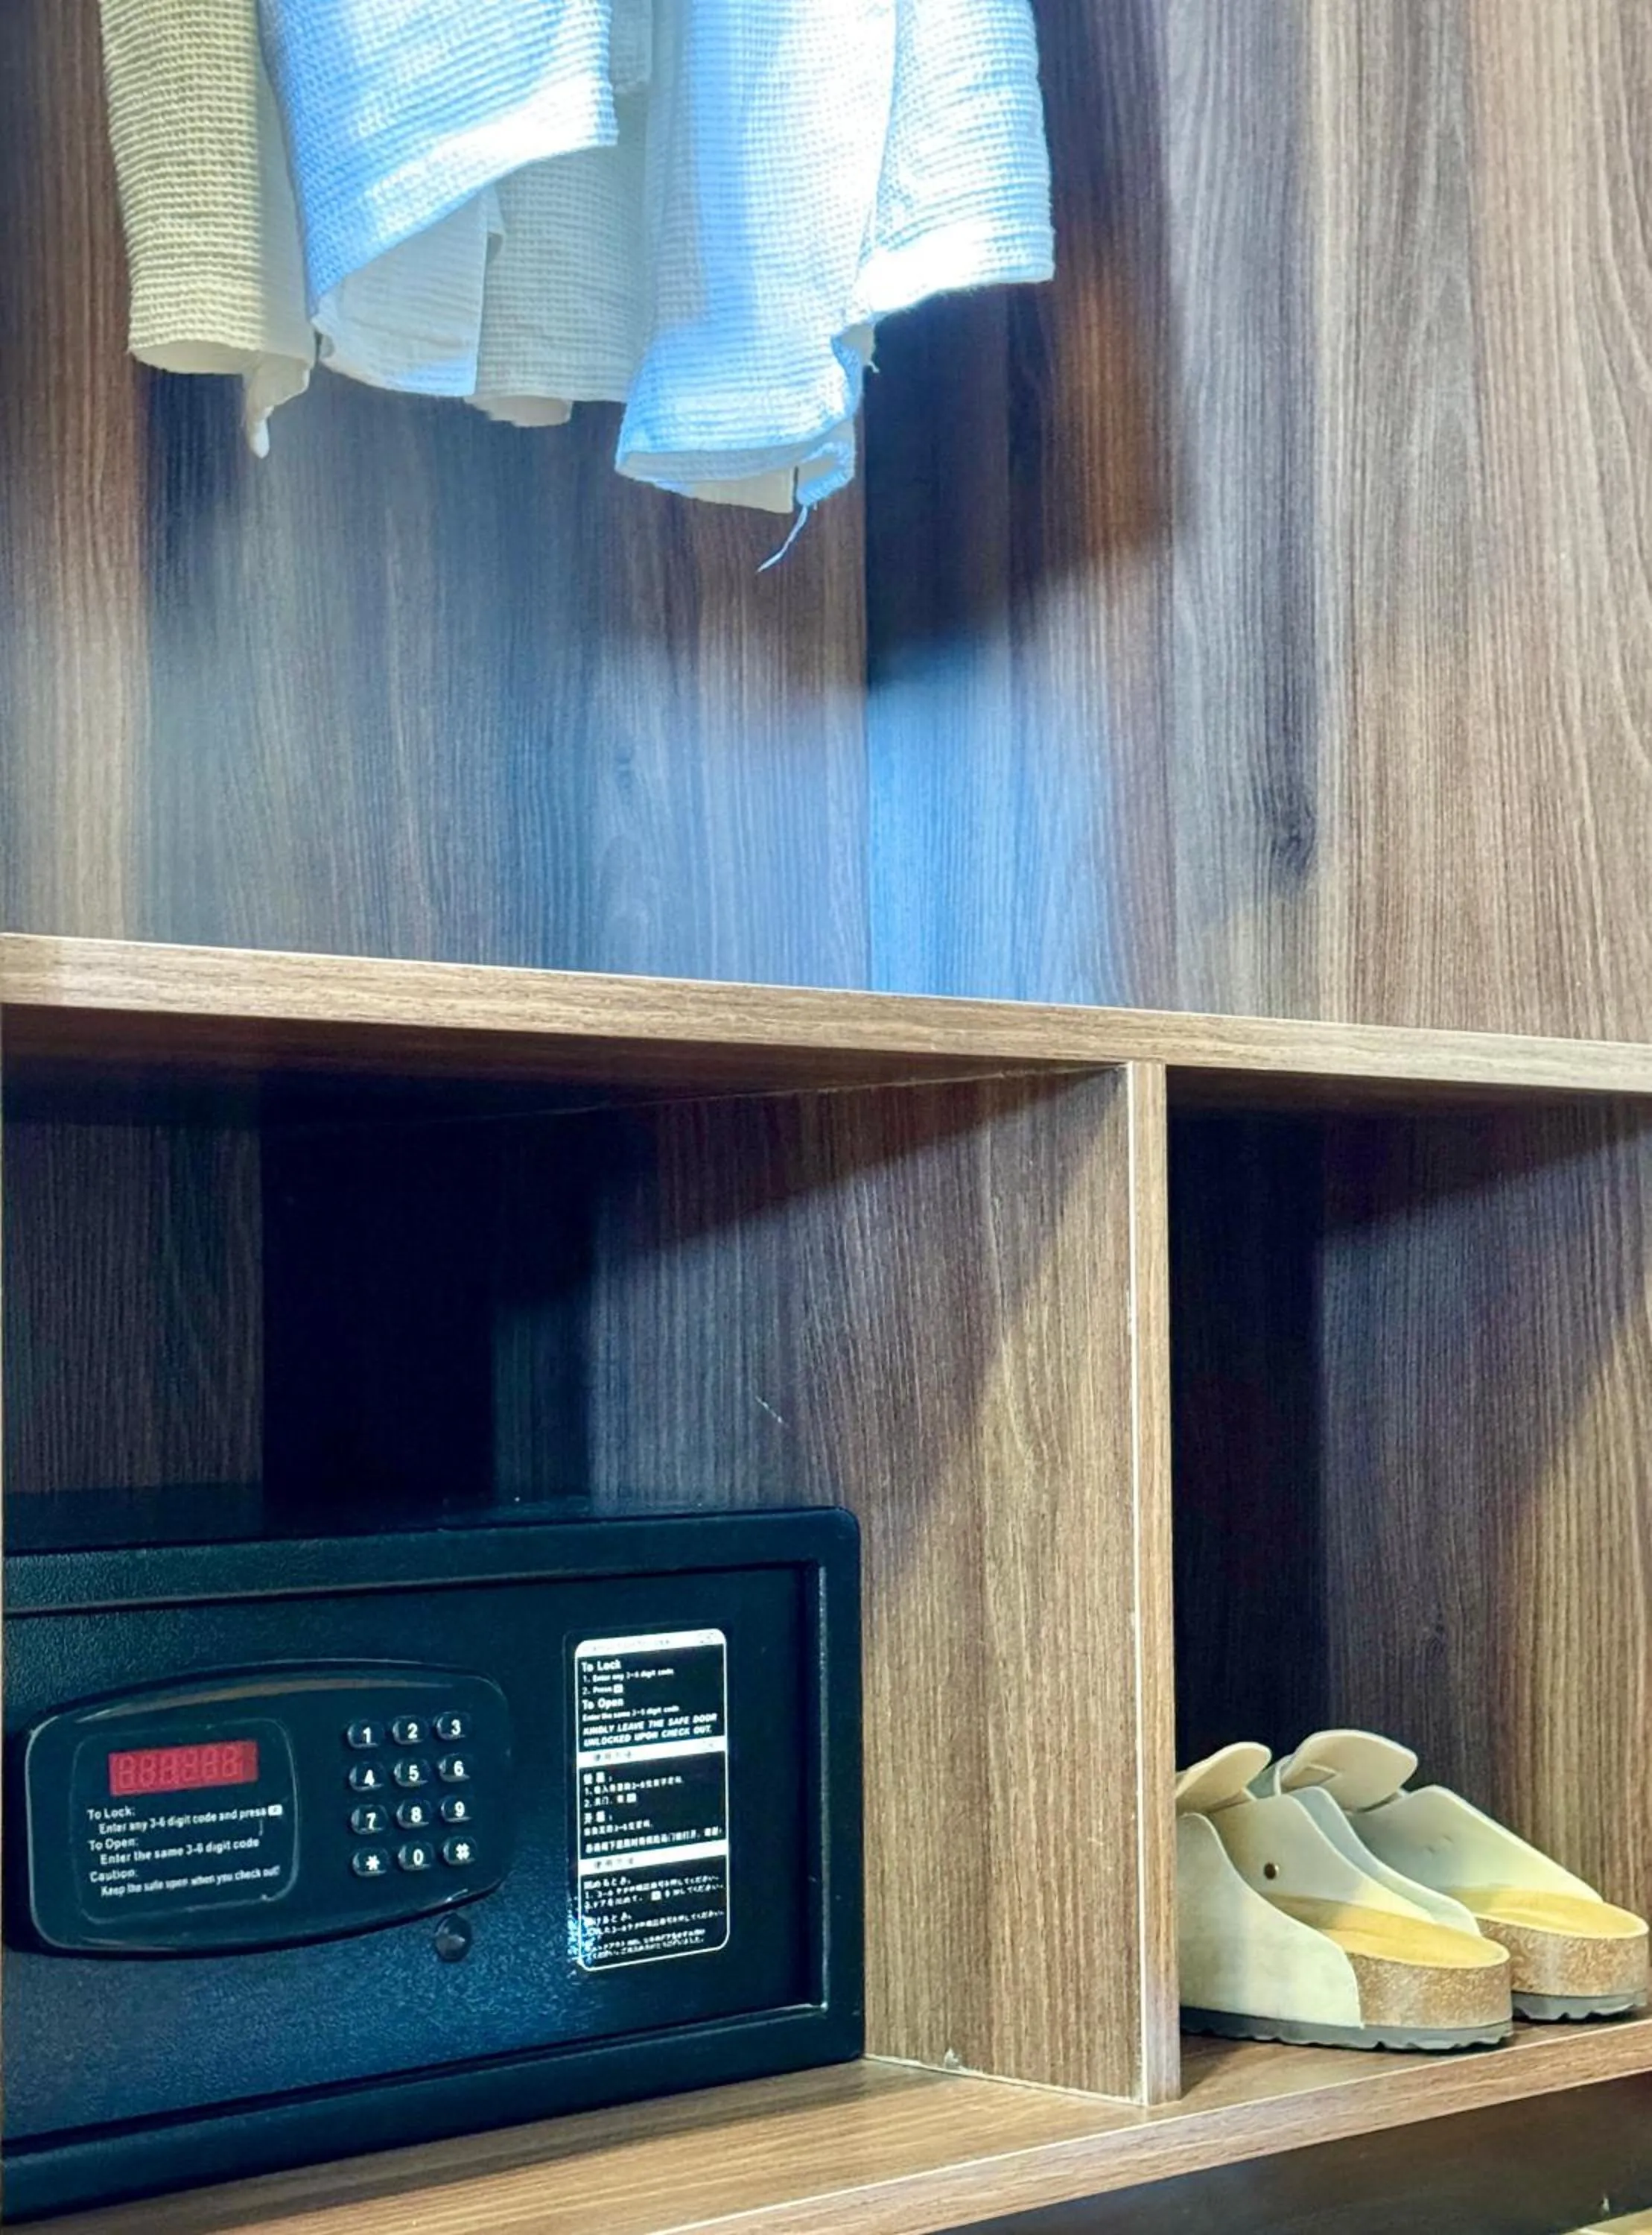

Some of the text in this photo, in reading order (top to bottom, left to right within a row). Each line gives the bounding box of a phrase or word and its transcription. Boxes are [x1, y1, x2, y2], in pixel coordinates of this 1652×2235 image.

[581, 1659, 621, 1673] To Lock
[582, 1698, 624, 1710] To Open
[363, 1719, 461, 1743] 1 2 3
[617, 1720, 644, 1732] LEAVE
[667, 1716, 690, 1726] SAFE
[583, 1734, 632, 1747] UNLOCKED
[661, 1727, 690, 1738] CHECK
[364, 1760, 464, 1785] 4 5 6
[87, 1809, 101, 1820] To
[99, 1822, 126, 1834] Enter
[129, 1822, 147, 1832] any
[167, 1814, 191, 1828] digit
[193, 1812, 217, 1824] code
[219, 1809, 238, 1821] and
[366, 1801, 465, 1829] 7 8 9
[88, 1839, 104, 1851] To
[100, 1853, 131, 1865] Enter
[133, 1850, 151, 1861] the
[154, 1847, 184, 1859] same
[205, 1840, 231, 1854] digit
[232, 1836, 259, 1850] code
[413, 1849, 424, 1865] 0
[456, 1843, 469, 1860] #
[101, 1886, 125, 1898] Keep
[127, 1882, 142, 1892] the
[144, 1880, 163, 1892] safe
[165, 1877, 188, 1889] open
[190, 1874, 215, 1886] when
[216, 1872, 233, 1886] you
[235, 1868, 261, 1880] check
